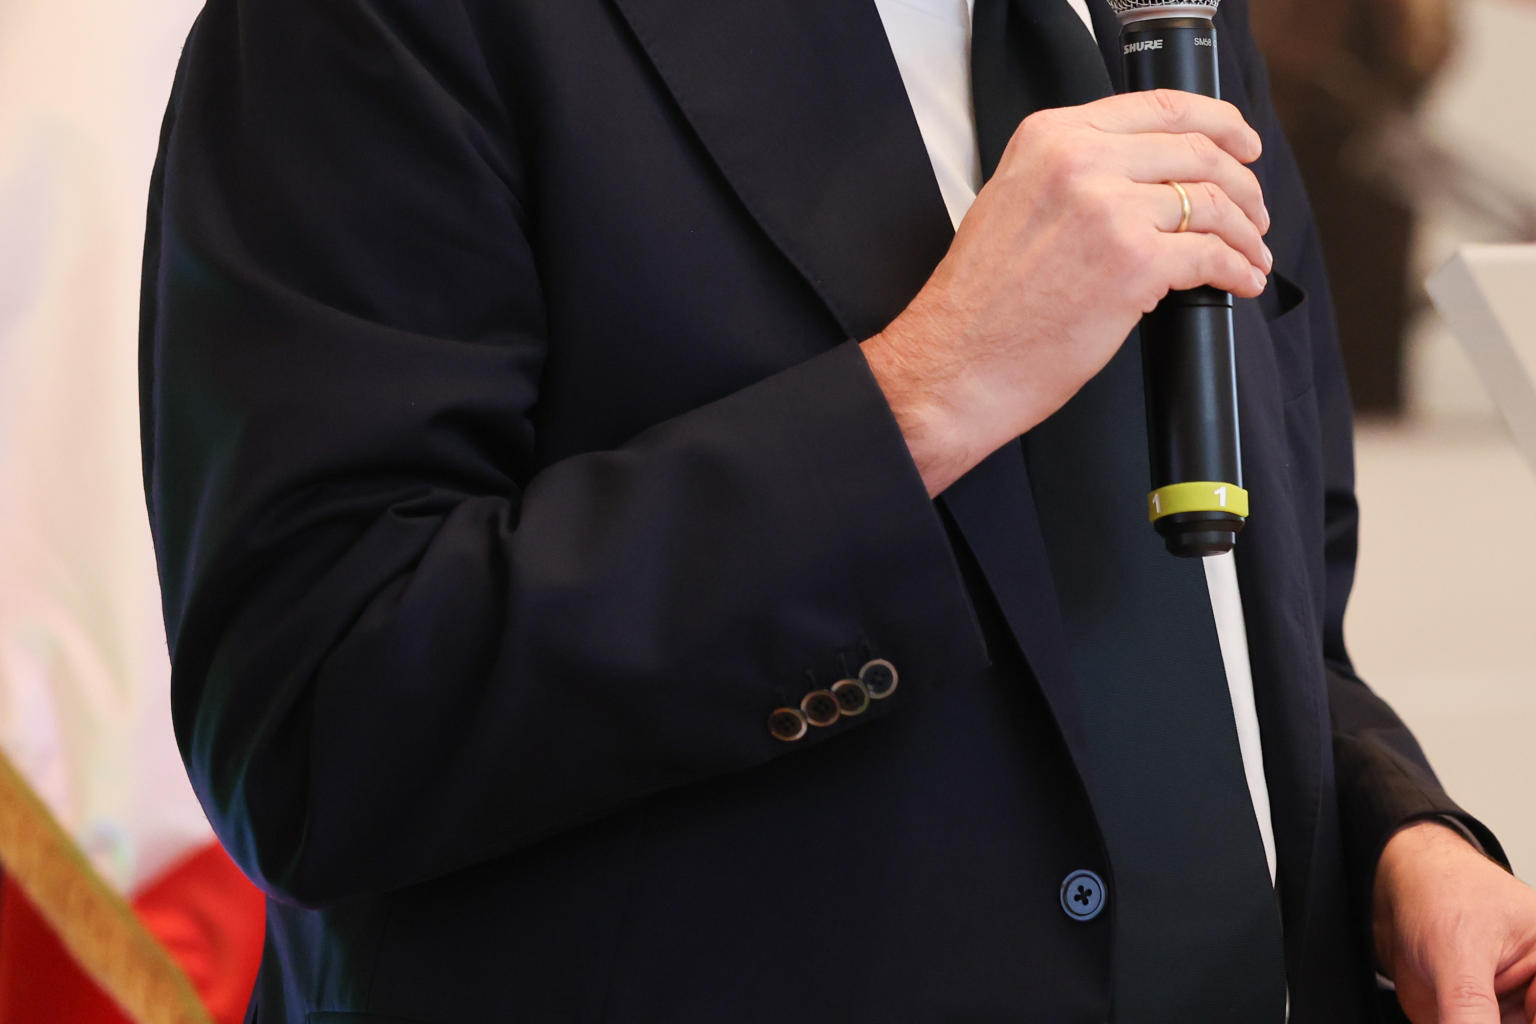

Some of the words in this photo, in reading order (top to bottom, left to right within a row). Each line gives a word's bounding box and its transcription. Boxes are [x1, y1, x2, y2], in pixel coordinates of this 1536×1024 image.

[1123, 39, 1164, 55] SHURE
[1152, 493, 1162, 514] 1
[1213, 486, 1227, 507] 1
